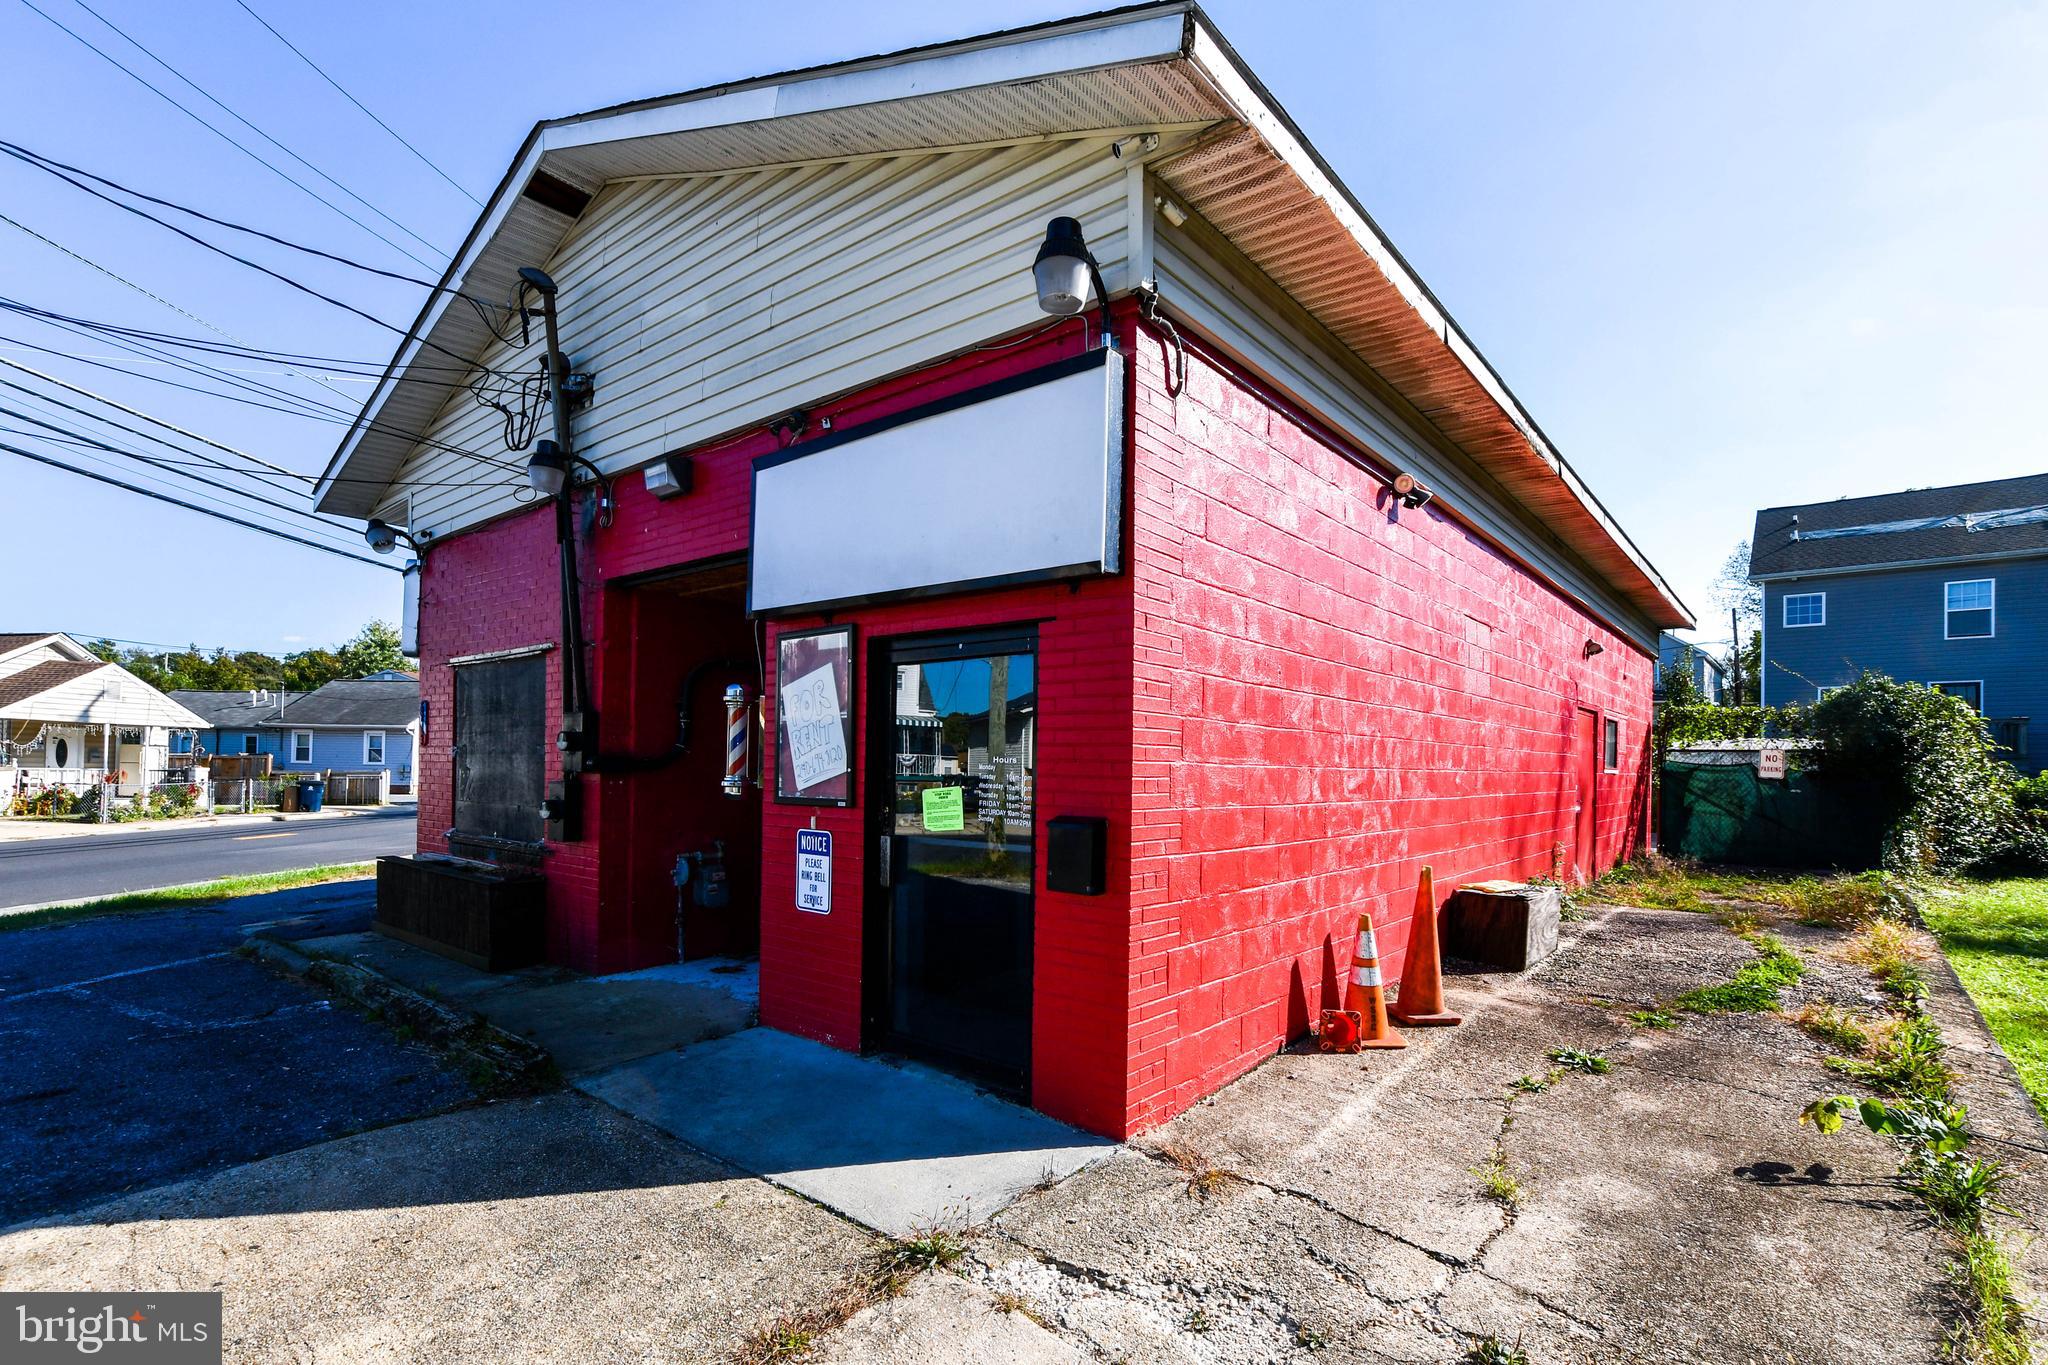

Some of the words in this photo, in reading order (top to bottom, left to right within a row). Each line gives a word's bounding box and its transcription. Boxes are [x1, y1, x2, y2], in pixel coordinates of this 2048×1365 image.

[790, 679, 831, 727] FOR
[791, 714, 835, 760] RENT
[993, 756, 1017, 764] Hours
[978, 763, 996, 771] Monday
[978, 808, 1006, 816] SATURDAY
[978, 814, 995, 824] Sunday
[801, 835, 827, 852] NOTICE
[805, 858, 822, 869] PLEASE
[801, 870, 812, 880] RING
[814, 871, 826, 882] BELL
[809, 883, 817, 892] FOR
[803, 893, 823, 906] SERVICE
